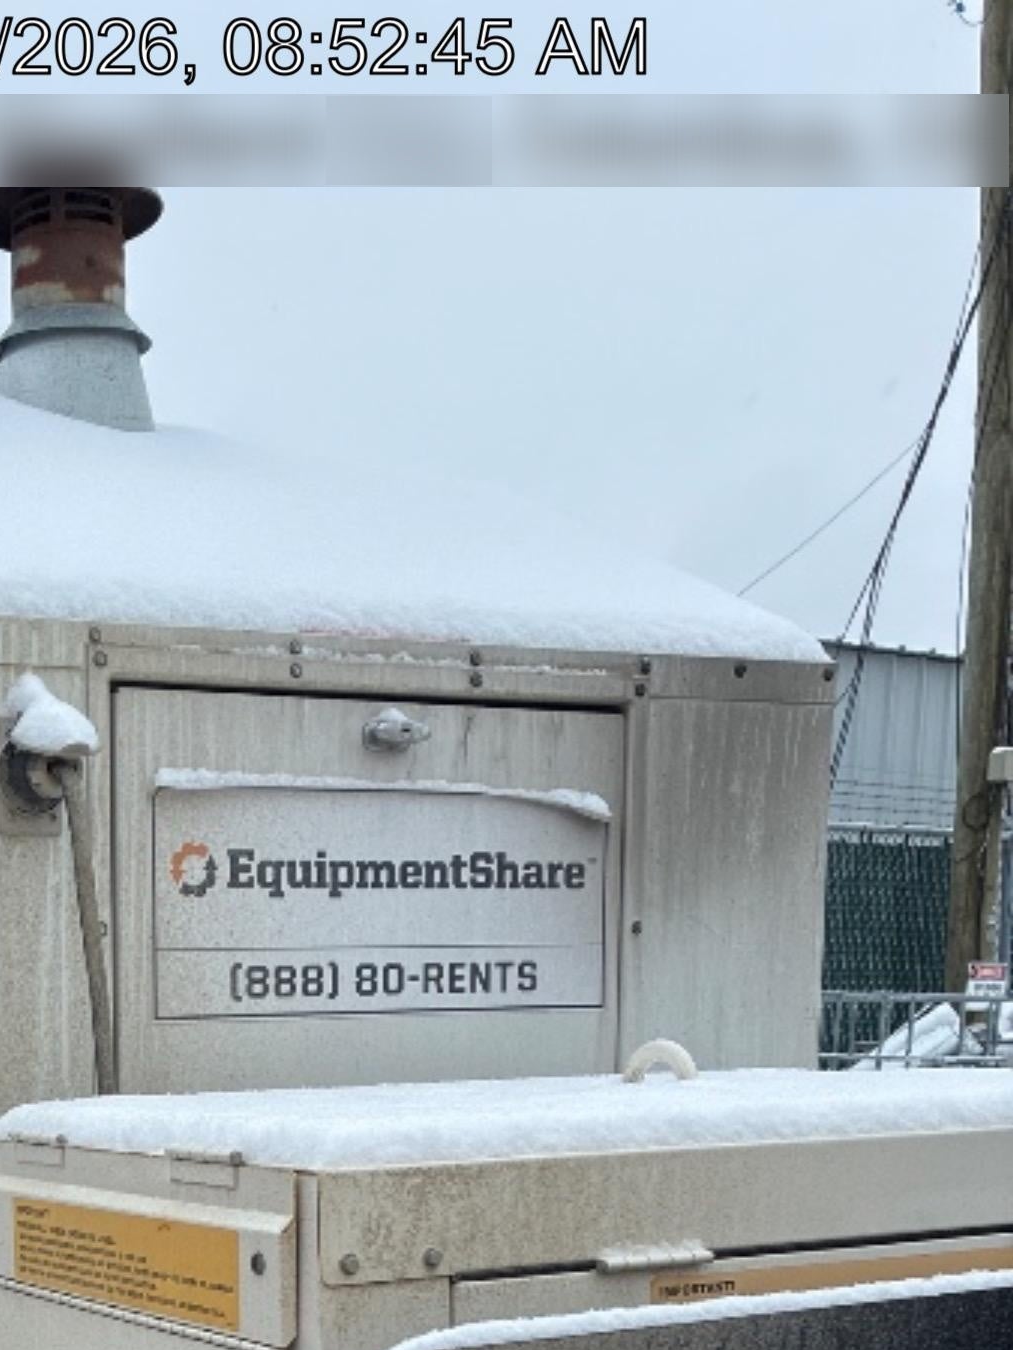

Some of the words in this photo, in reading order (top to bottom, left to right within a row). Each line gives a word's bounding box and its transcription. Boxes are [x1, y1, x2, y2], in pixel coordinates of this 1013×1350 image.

[227, 848, 586, 898] EquipmentShare
[229, 961, 339, 1001] (888)
[354, 960, 539, 997] 80-RENTS
